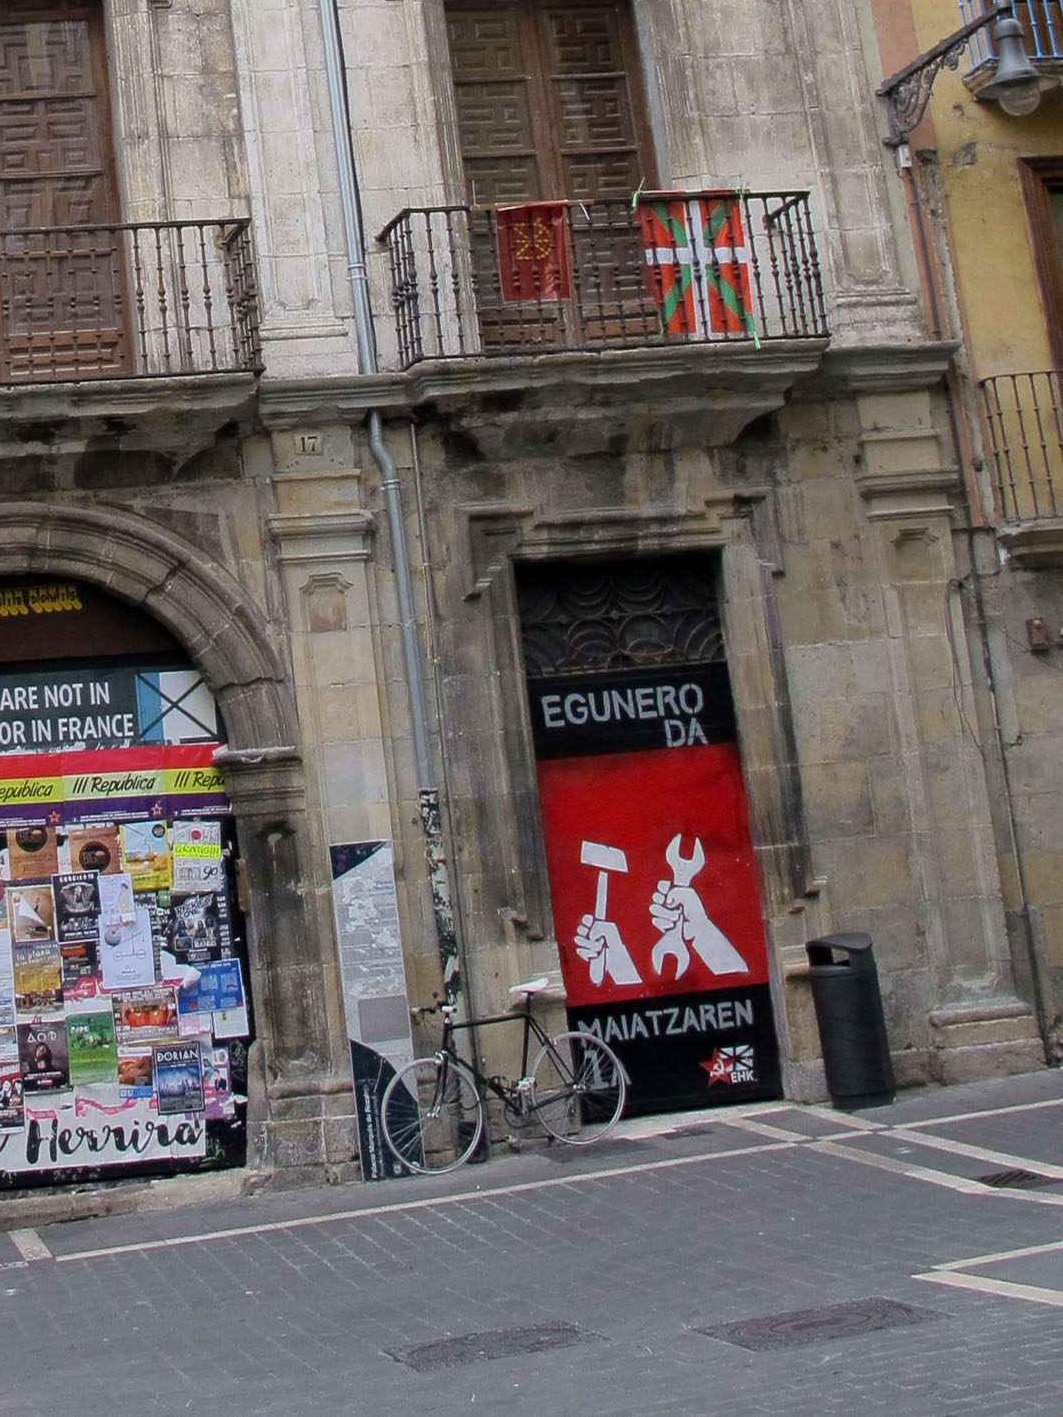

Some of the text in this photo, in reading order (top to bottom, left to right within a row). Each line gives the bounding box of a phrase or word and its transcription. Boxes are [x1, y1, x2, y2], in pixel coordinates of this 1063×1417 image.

[300, 435, 317, 452] 17
[0, 685, 38, 711] ARE
[44, 683, 84, 708] NOT
[90, 681, 110, 706] IN
[541, 683, 704, 728] EGUNERO
[32, 719, 52, 743] IN
[58, 713, 134, 742] FRANCE
[665, 716, 708, 748] DA
[91, 773, 156, 796] República
[577, 999, 753, 1048] MAIATZAREN
[157, 1049, 198, 1063] DORIAN
[26, 1117, 204, 1164] Herrira
